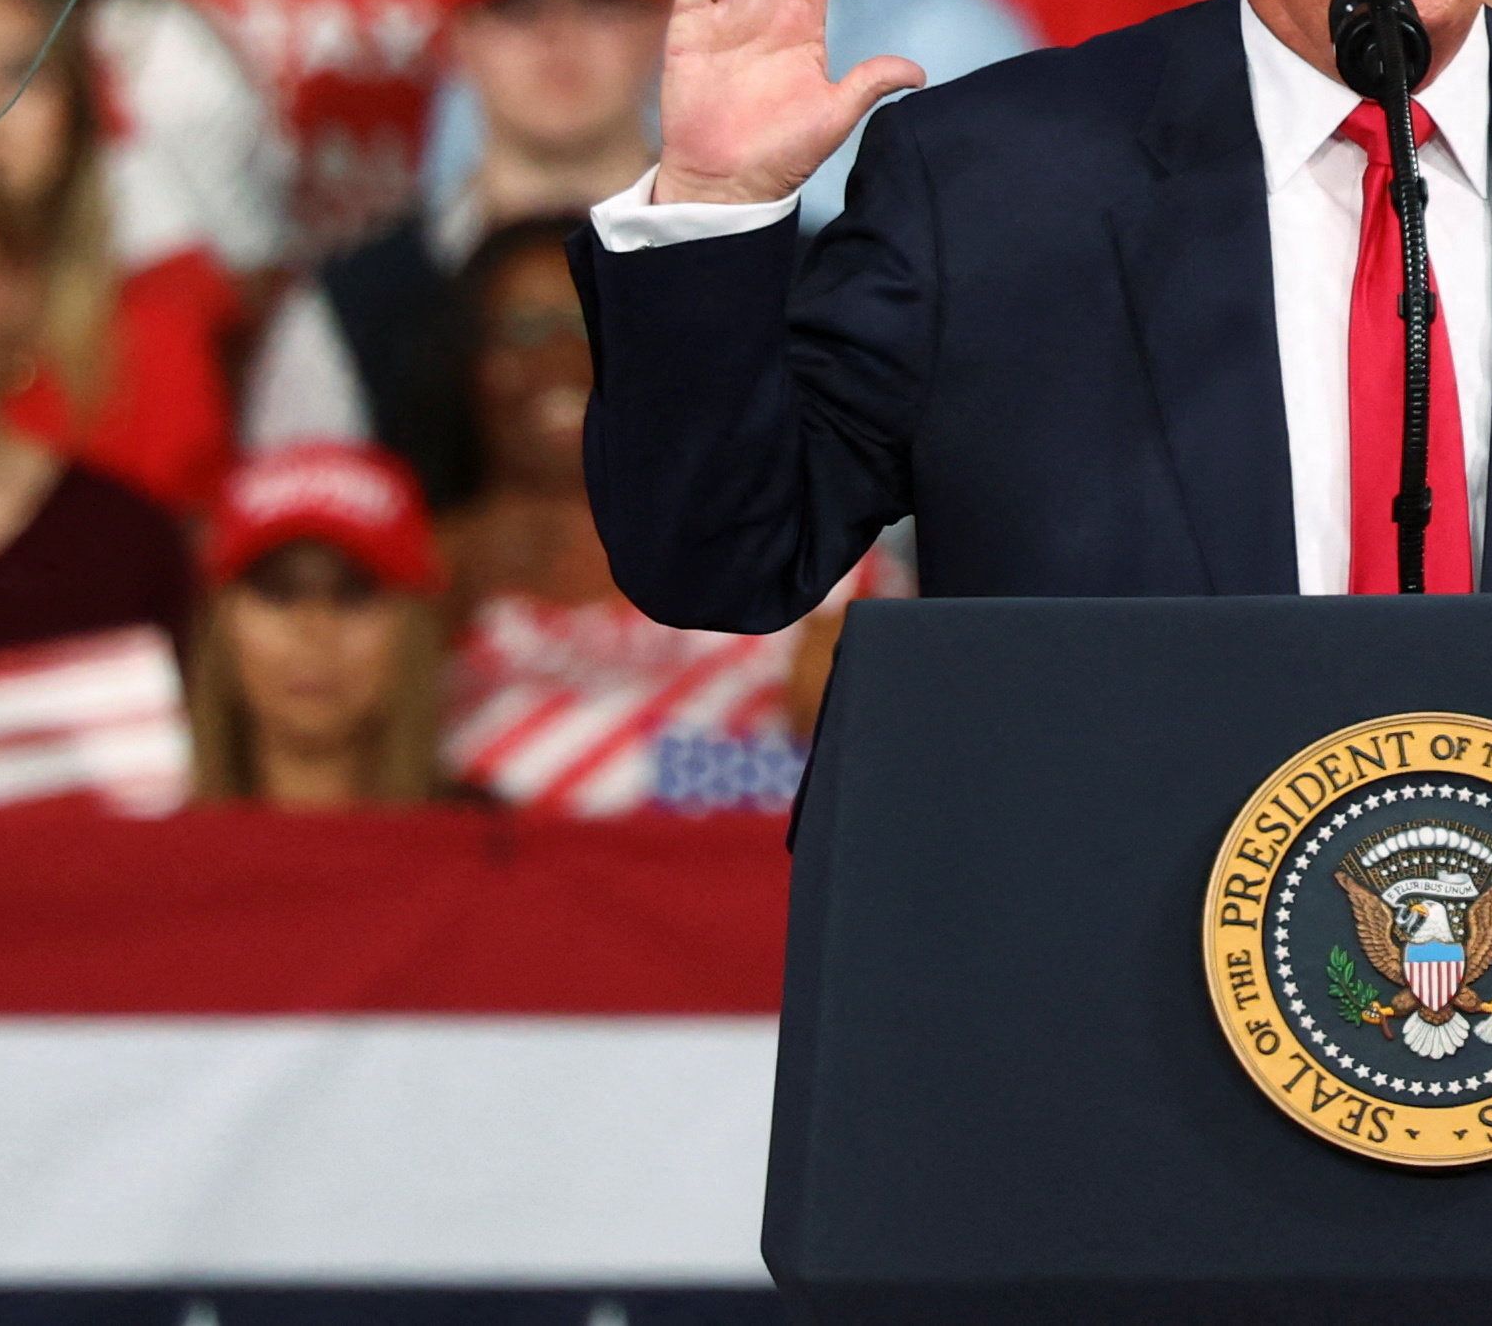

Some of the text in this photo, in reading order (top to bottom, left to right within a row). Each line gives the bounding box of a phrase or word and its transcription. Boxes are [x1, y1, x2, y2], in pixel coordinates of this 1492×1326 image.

[1431, 734, 1471, 761] OF
[1220, 731, 1415, 931] PRESIDENT
[1393, 881, 1444, 896] PLURIBUS
[1444, 885, 1474, 896] UNUM
[1227, 948, 1261, 1010] THE
[1247, 1018, 1282, 1056] OF
[1291, 1052, 1396, 1143] SEAL
